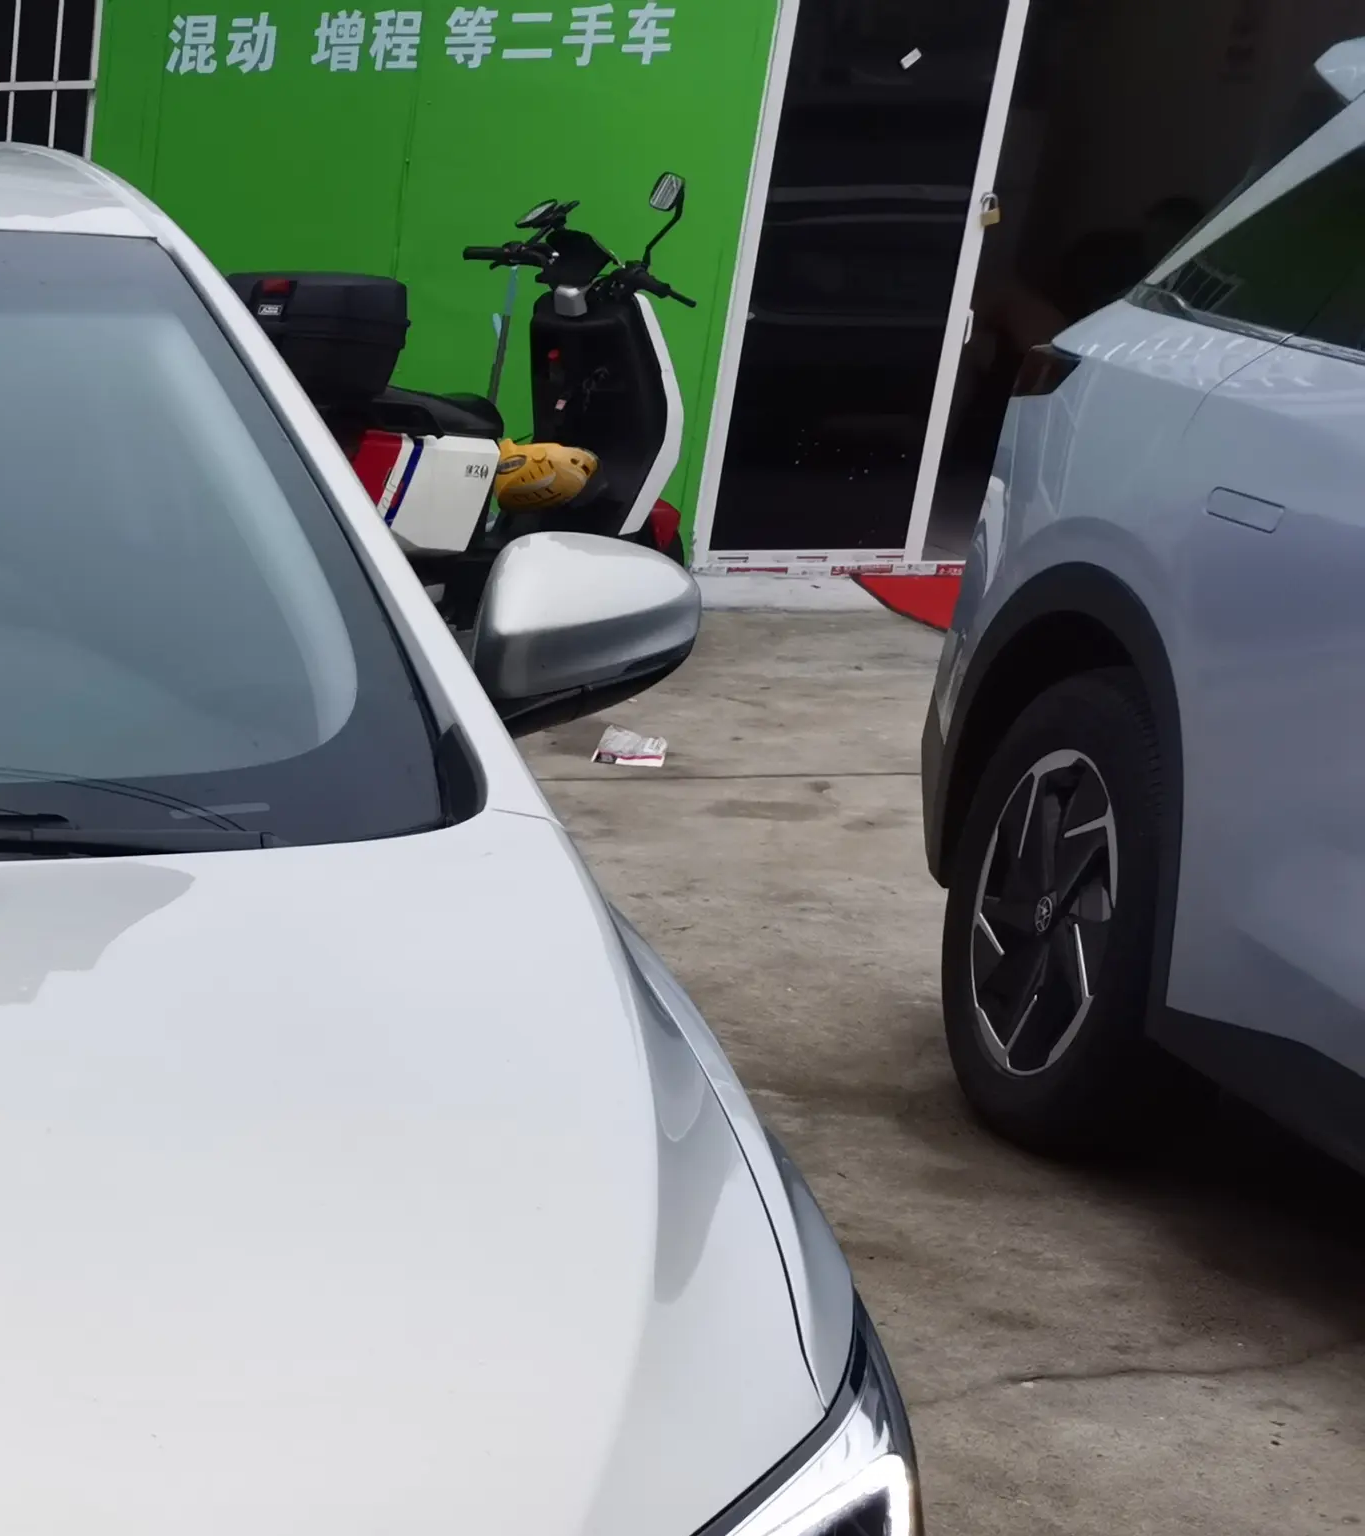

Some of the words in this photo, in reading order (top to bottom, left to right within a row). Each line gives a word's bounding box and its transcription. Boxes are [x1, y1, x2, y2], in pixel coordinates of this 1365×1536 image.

[165, 12, 277, 75] 混动
[311, 9, 423, 72] 增程
[444, 2, 676, 69] 等二手车
